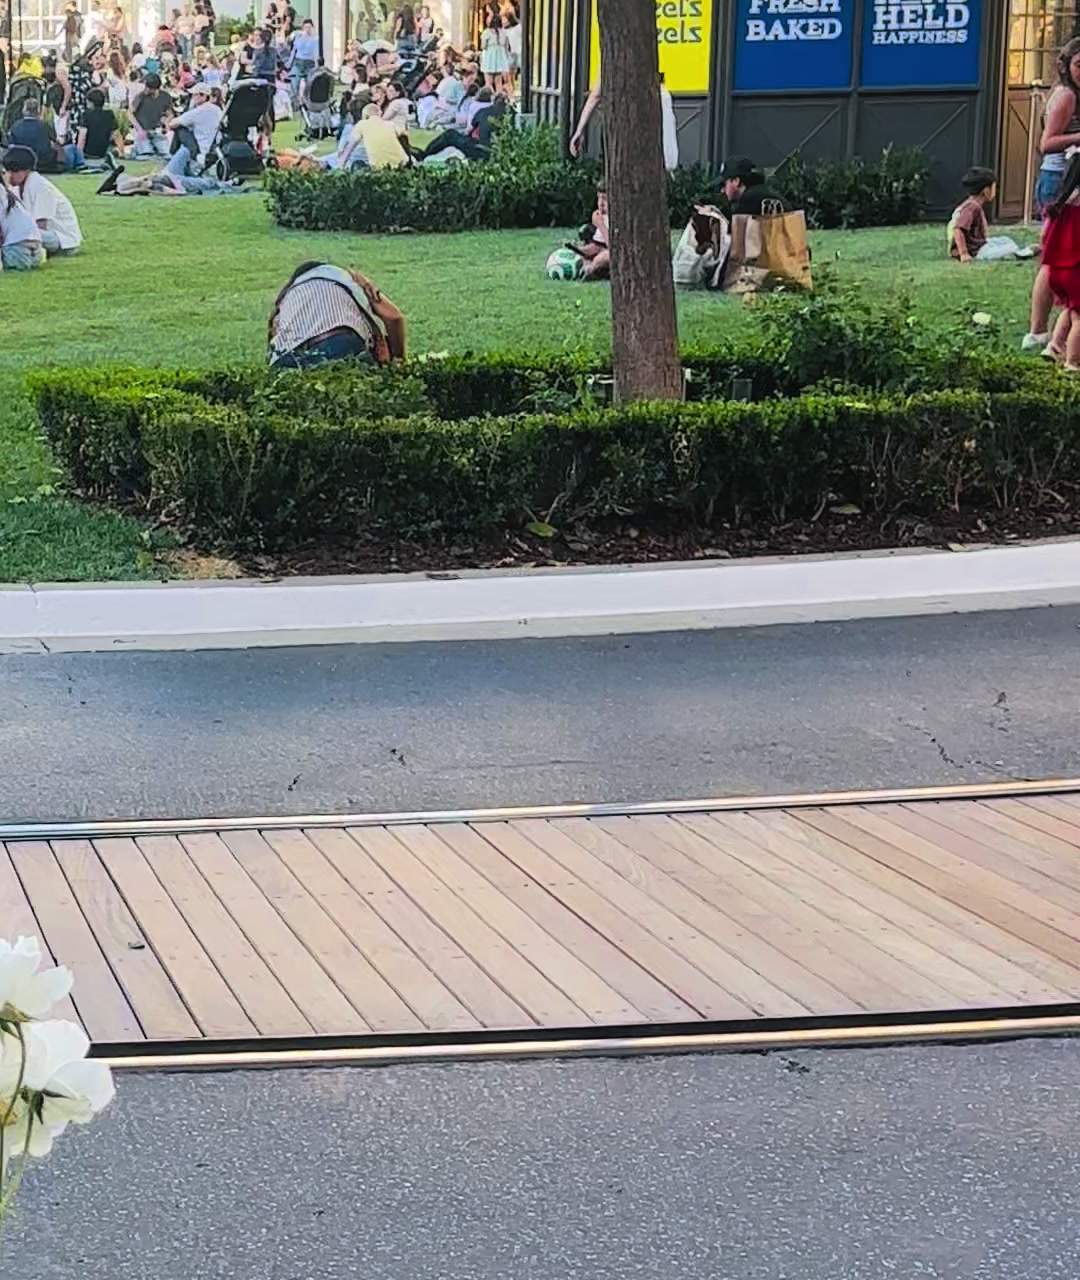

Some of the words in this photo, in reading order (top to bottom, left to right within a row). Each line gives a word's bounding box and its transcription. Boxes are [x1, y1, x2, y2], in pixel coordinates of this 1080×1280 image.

[872, 4, 971, 30] HELD
[745, 18, 843, 41] BAKED
[871, 29, 969, 45] HAPPINESS
